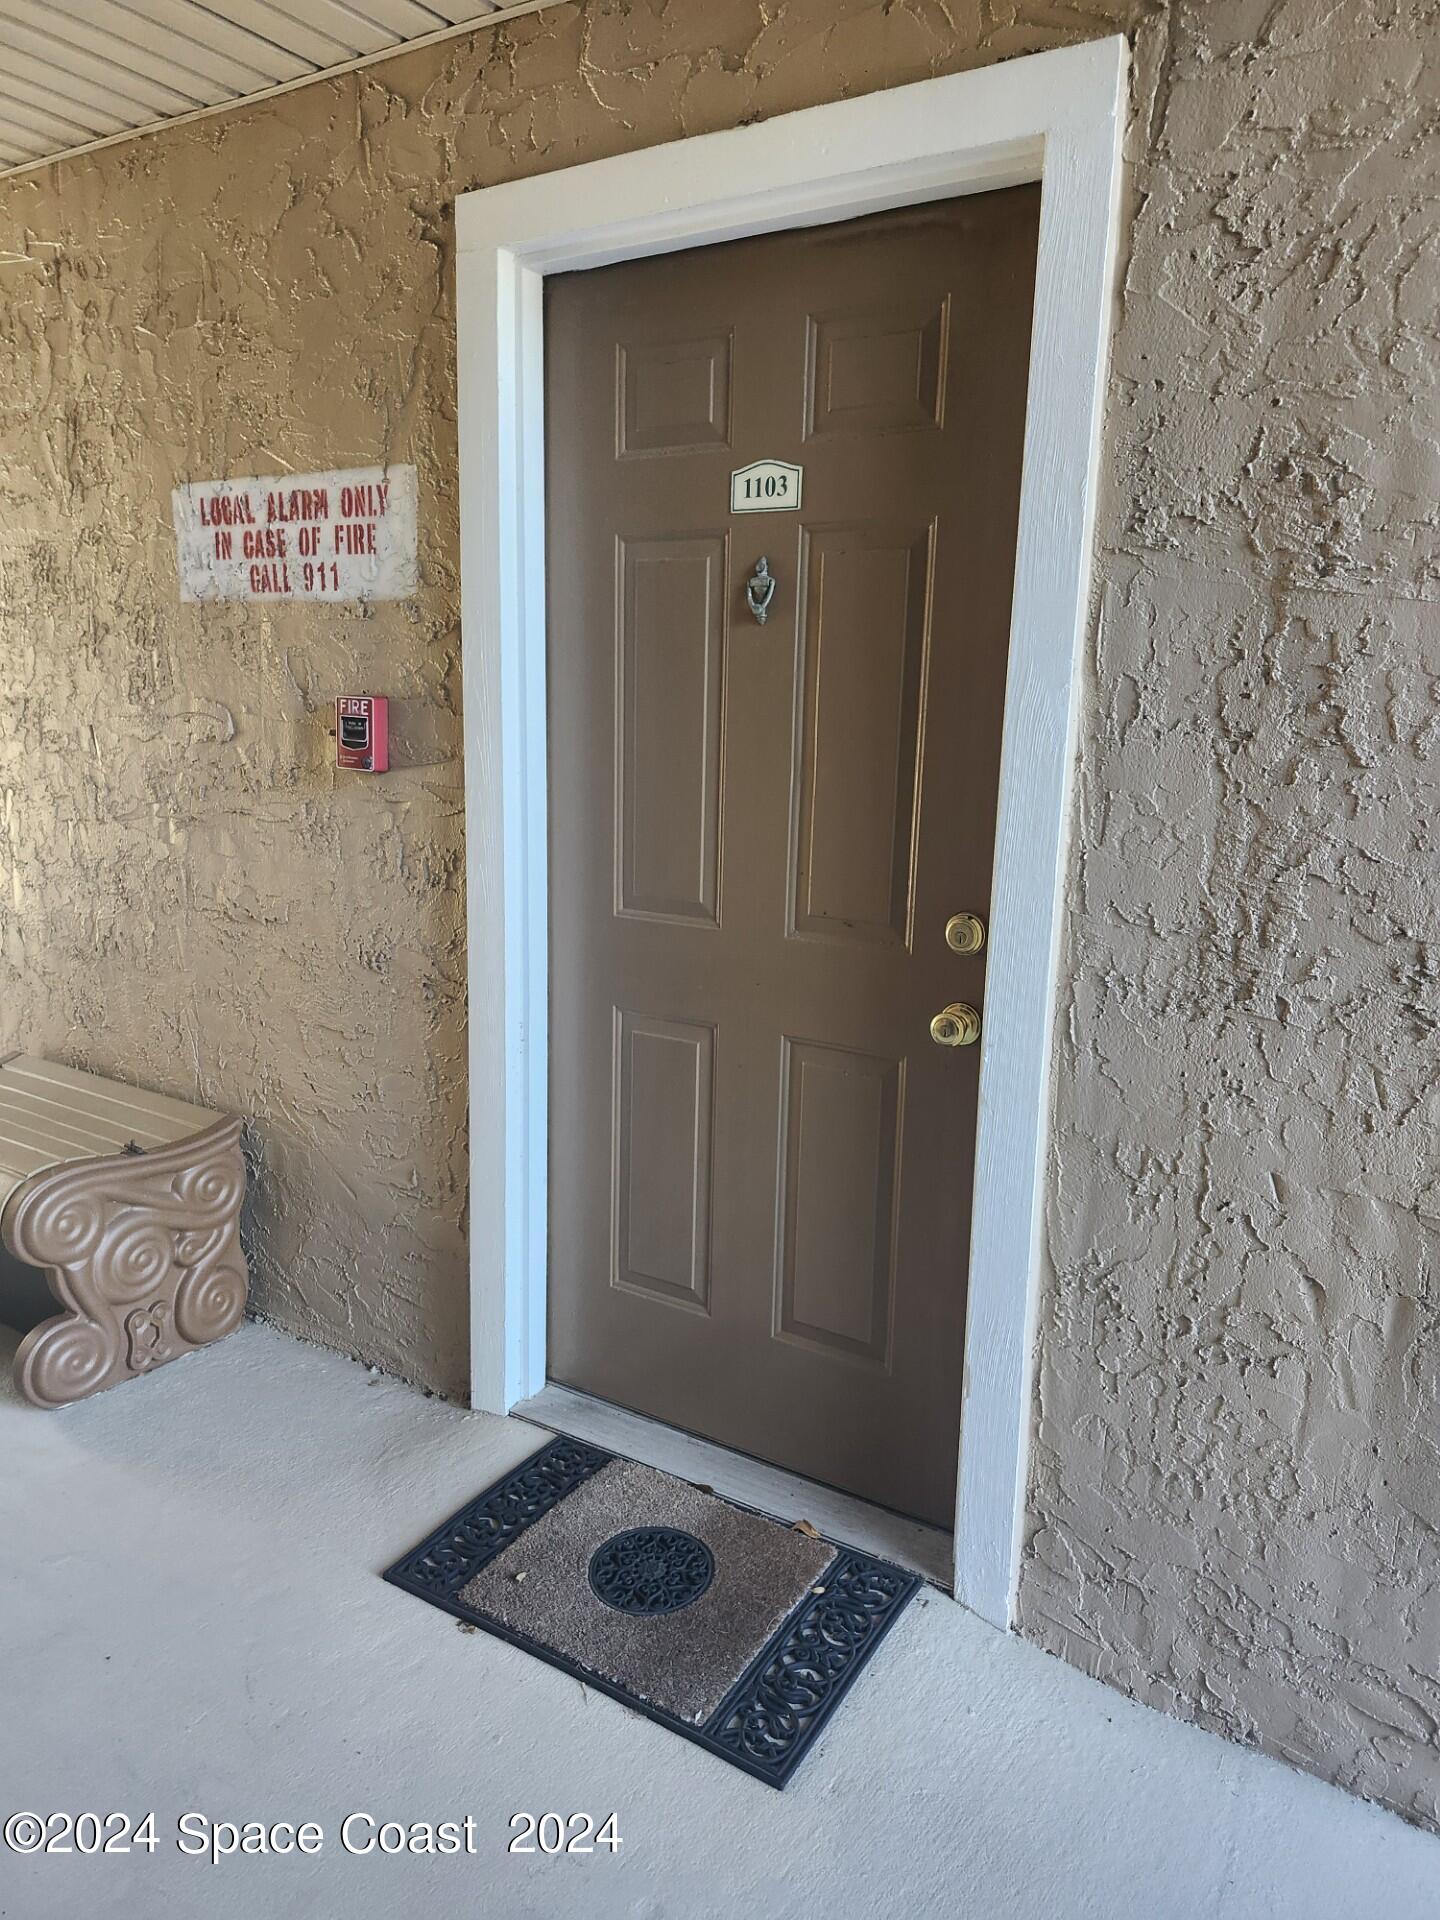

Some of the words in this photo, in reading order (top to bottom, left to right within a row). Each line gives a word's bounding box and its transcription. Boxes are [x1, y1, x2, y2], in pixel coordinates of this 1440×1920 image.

[744, 475, 788, 499] 1103
[200, 494, 256, 527] LOCAL
[267, 489, 329, 523] ALARM
[341, 484, 389, 518] ONLY
[214, 531, 232, 560] IN
[243, 528, 287, 560] CASE
[299, 526, 321, 557] OF
[334, 523, 377, 555] FIRE
[250, 562, 292, 593] CALL
[303, 562, 340, 592] 911
[340, 699, 369, 716] FIRE
